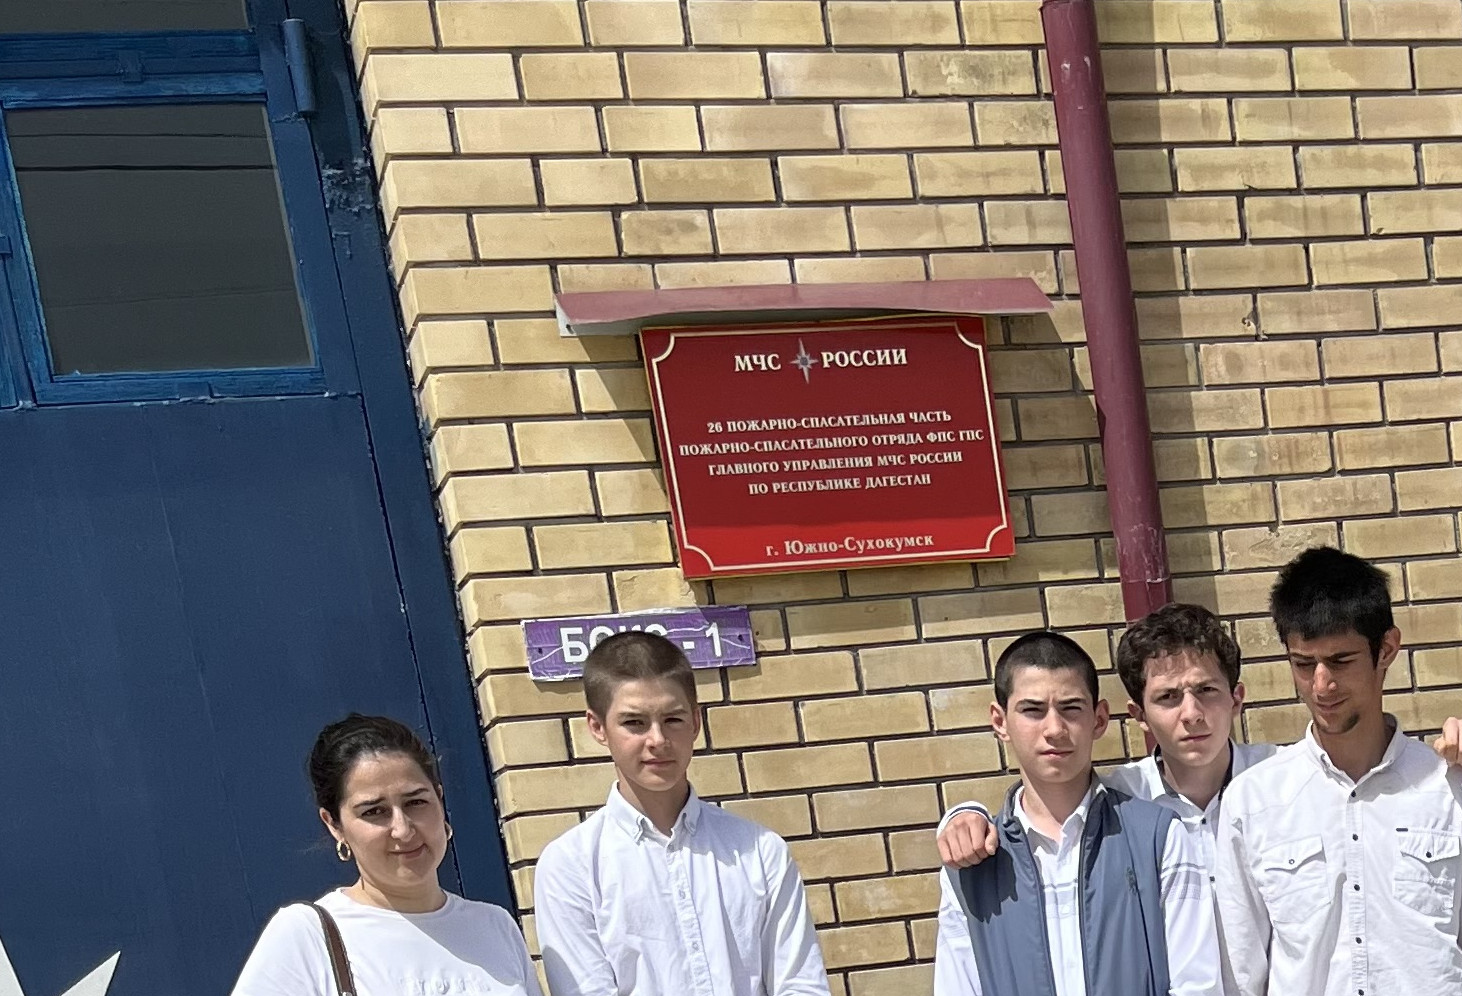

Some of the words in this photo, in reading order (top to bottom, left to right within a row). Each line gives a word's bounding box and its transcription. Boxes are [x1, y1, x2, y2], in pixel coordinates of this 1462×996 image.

[733, 352, 782, 373] МЧС
[820, 347, 908, 368] РОССИИ
[707, 422, 723, 434] 26
[727, 412, 906, 433] ПОЖАРНО-СПАСАТЕЛЬНАЯ
[909, 410, 952, 424] ЧАСТЬ
[679, 435, 869, 457] ПОЖАРНО-СПАСАТЕЛЬНОГО
[872, 431, 924, 447] ОТРЯДА
[926, 430, 956, 443] ФПС
[959, 429, 984, 442] ГПС
[708, 462, 780, 477] ГЛАВНОГО
[783, 456, 873, 472] УПРАВЛЕНИЯ
[877, 453, 907, 467] МЧС
[909, 451, 963, 464] РОССИИ
[748, 483, 769, 495] ПО
[772, 478, 862, 494] РЕСПУБЛИКЕ
[865, 474, 931, 490] ДАГЕСТАН
[766, 546, 779, 556] г.
[784, 533, 934, 557] Южно-Сухокумск
